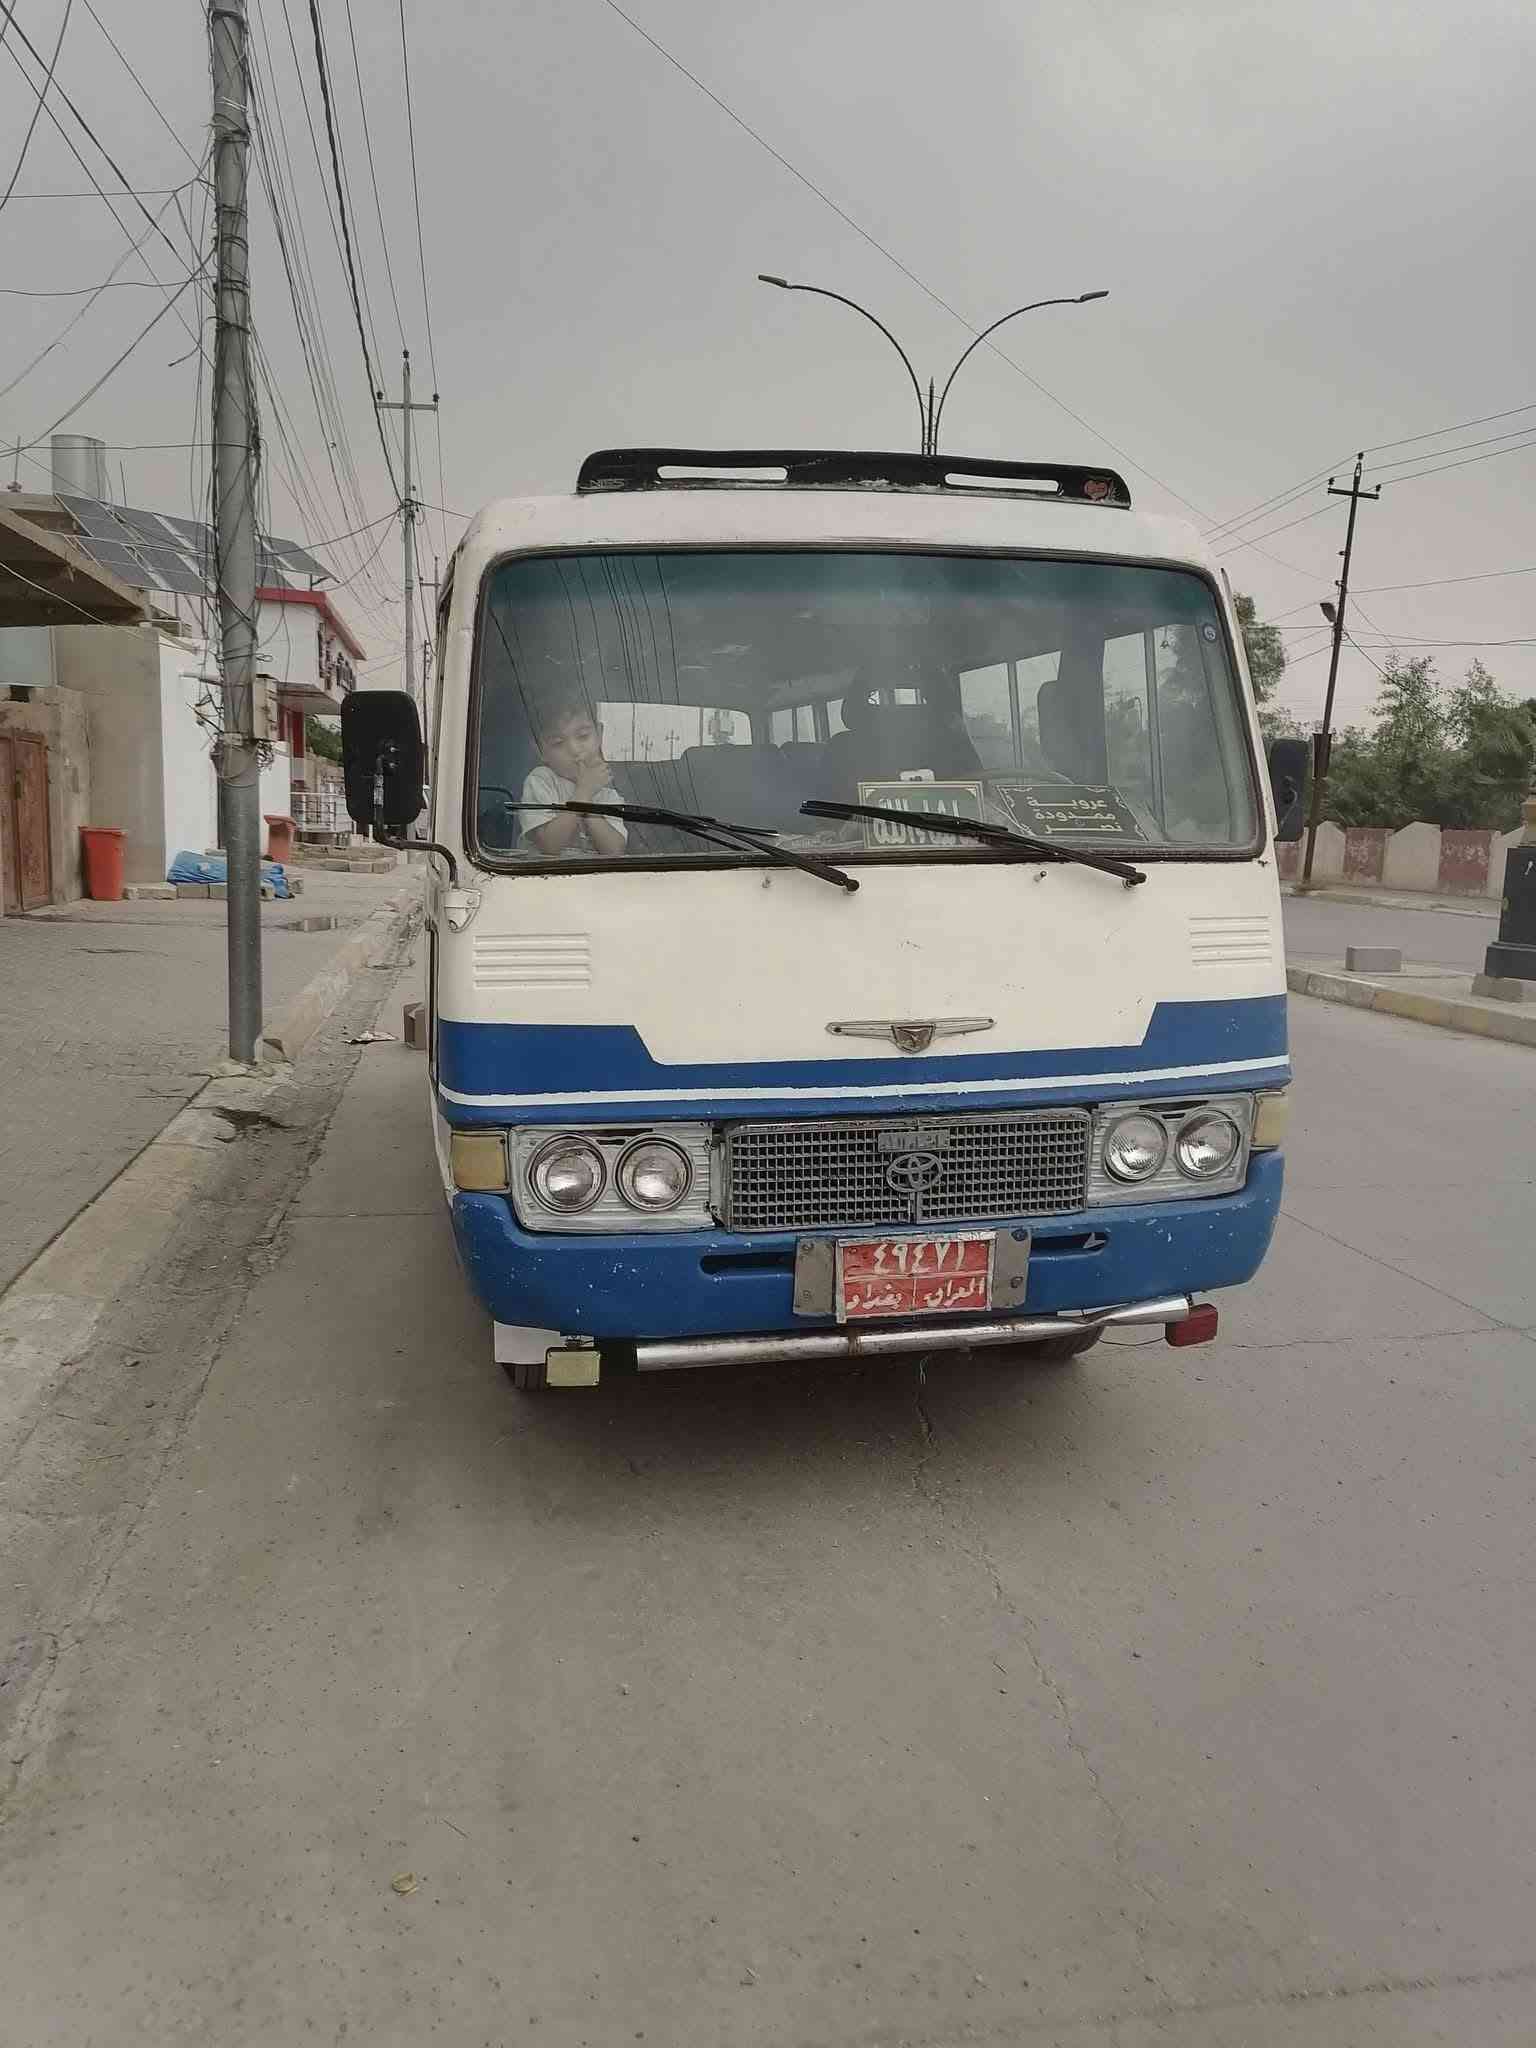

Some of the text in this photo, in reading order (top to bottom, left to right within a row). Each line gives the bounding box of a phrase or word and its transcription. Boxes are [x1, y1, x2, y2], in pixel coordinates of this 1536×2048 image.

[1026, 797, 1107, 809] عروبة
[1044, 822, 1123, 834] نصر
[873, 1242, 966, 1274] ٤٩٤٧١
[846, 1277, 985, 1310] العراق بغداد
